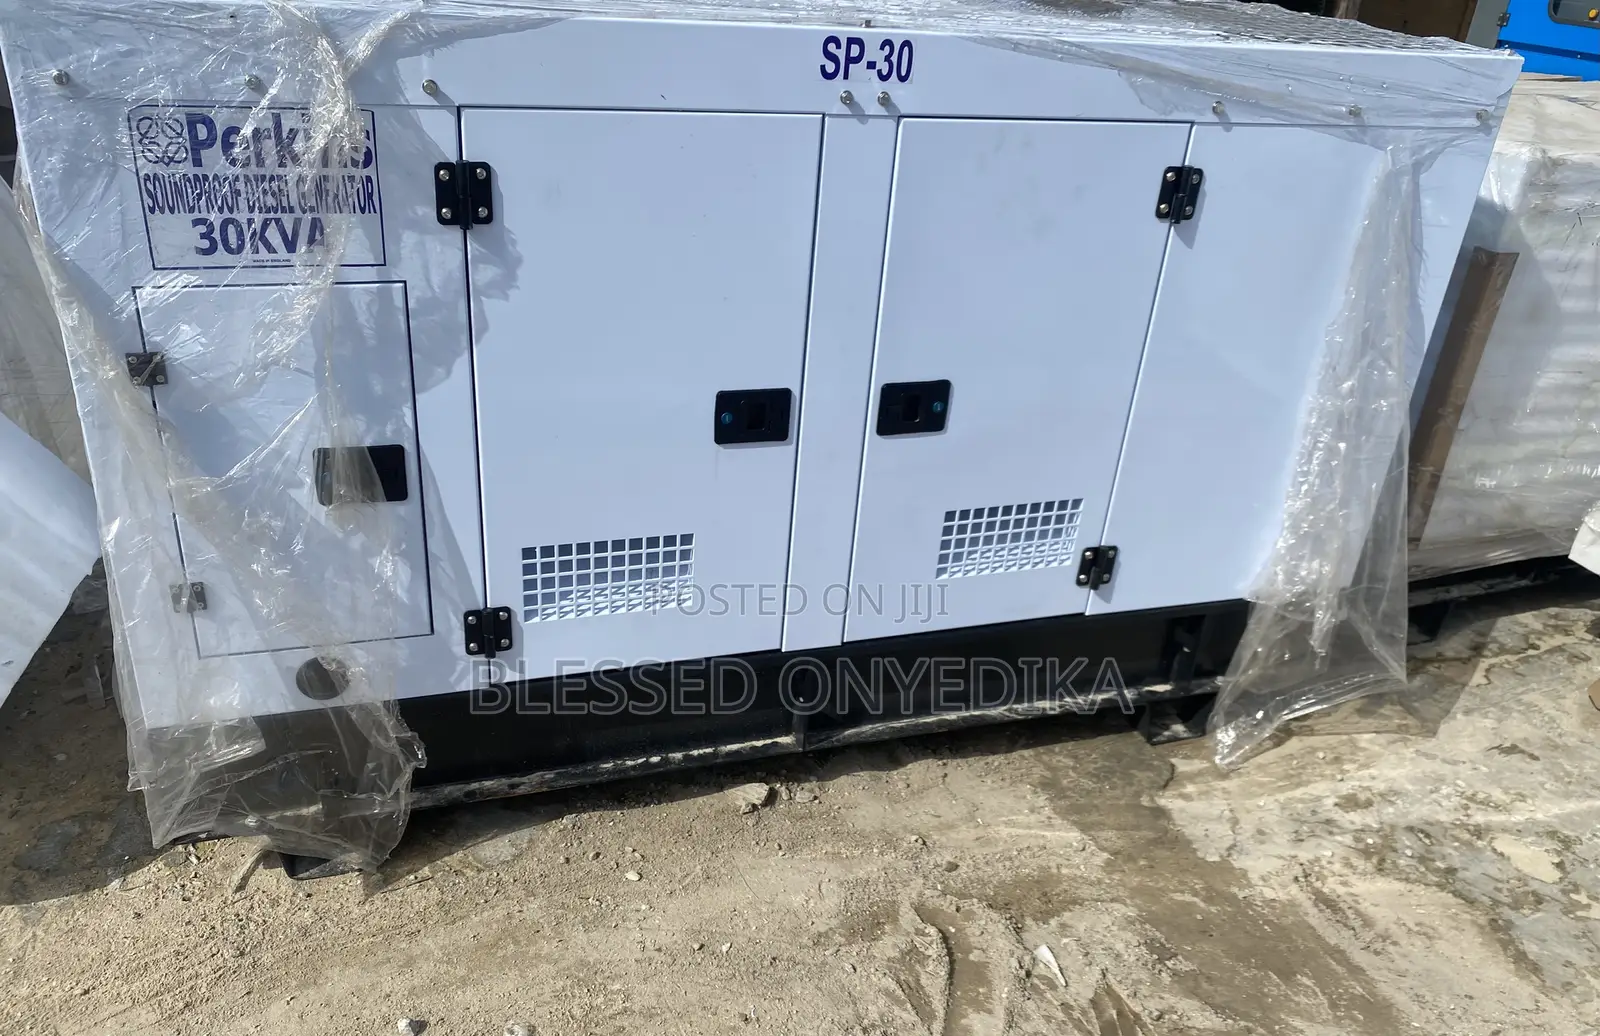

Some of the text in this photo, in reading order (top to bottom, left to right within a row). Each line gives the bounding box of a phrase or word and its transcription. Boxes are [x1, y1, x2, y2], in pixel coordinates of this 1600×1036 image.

[820, 35, 913, 82] SP-30
[143, 173, 241, 214] SOUNDPROOF
[243, 174, 295, 214] DIESEL
[191, 217, 327, 256] 30KVA
